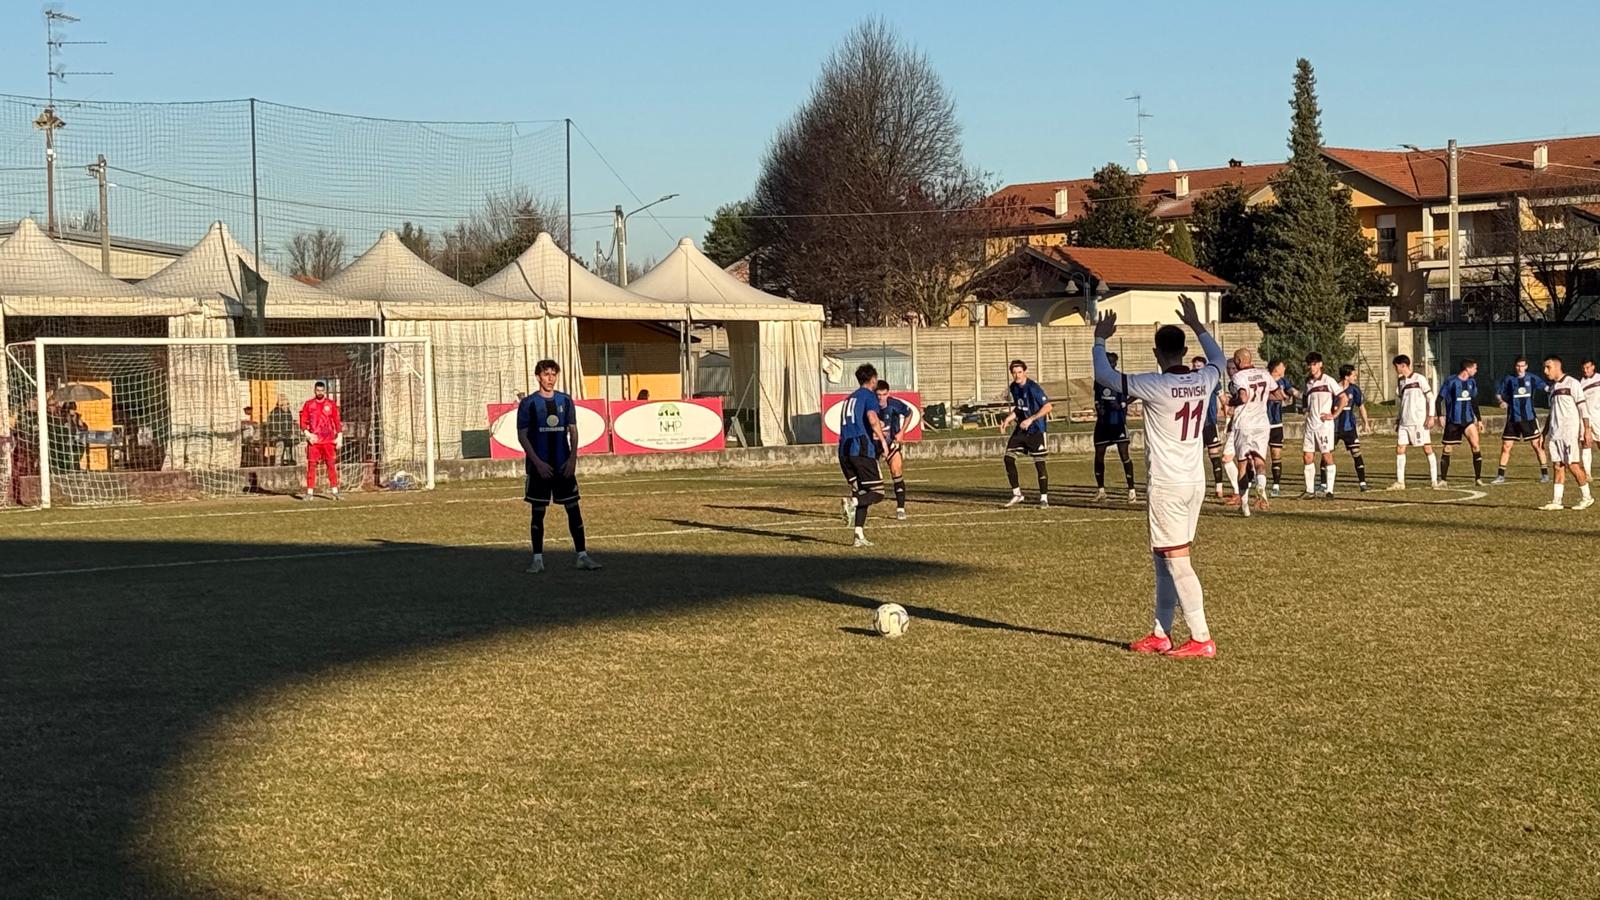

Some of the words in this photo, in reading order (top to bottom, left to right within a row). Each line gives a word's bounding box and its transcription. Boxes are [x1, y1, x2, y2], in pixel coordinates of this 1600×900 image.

[1249, 381, 1267, 402] 77
[842, 398, 857, 425] 14
[1175, 400, 1204, 441] 11
[659, 420, 682, 432] NHP
